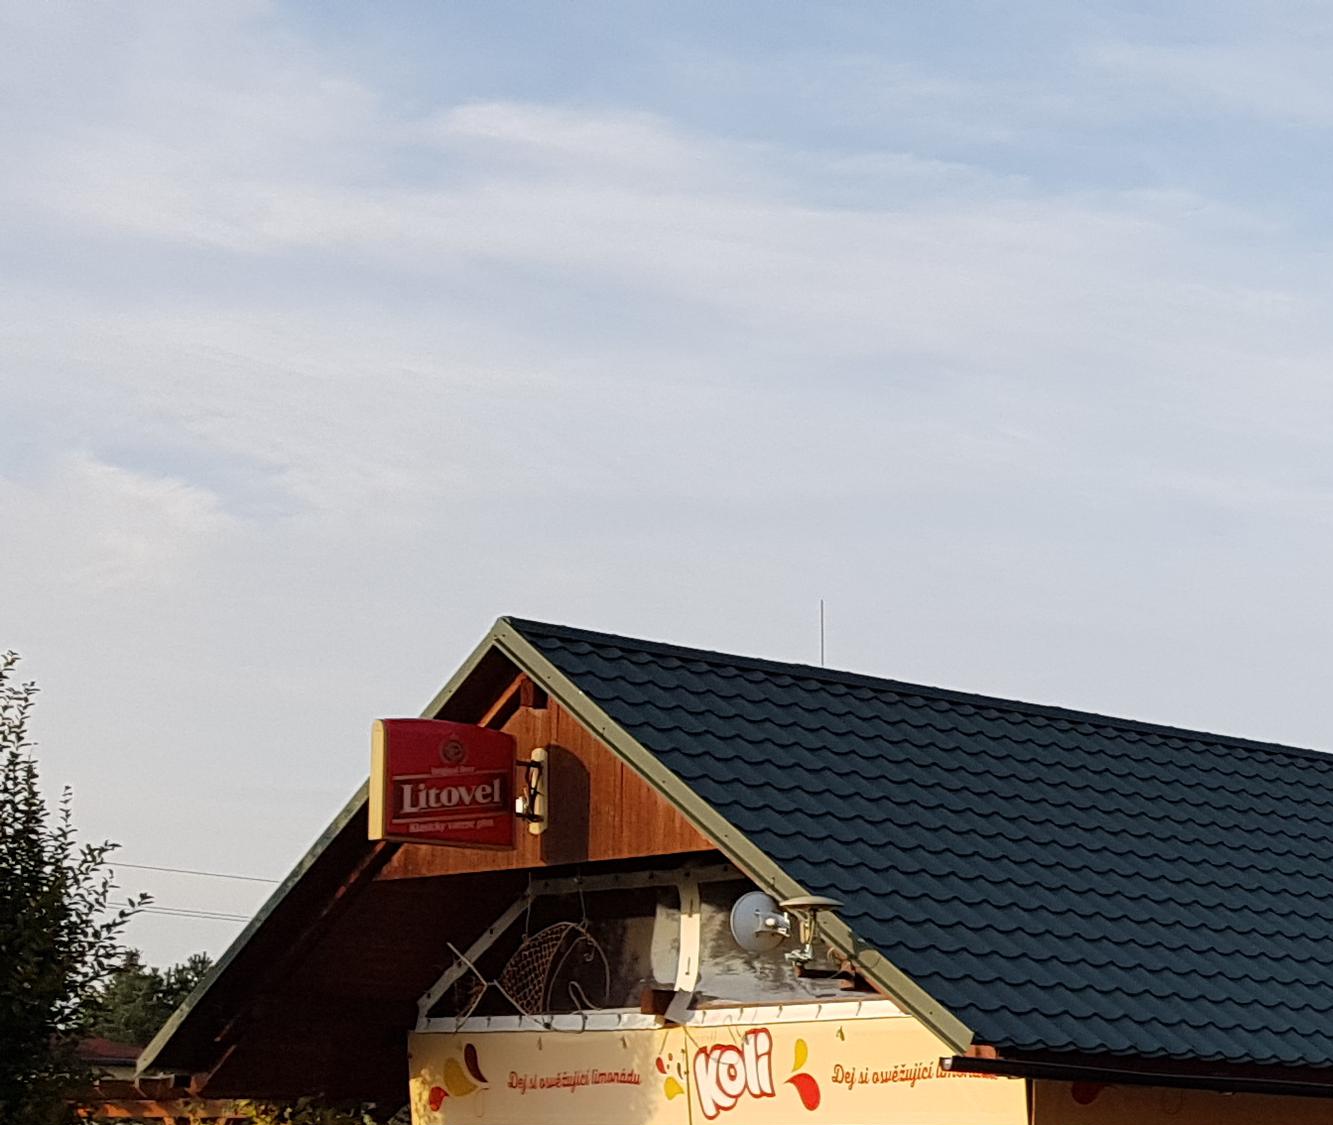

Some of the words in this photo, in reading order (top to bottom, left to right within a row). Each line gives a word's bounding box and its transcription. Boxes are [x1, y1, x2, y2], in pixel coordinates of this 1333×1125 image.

[401, 778, 500, 813] Litovel
[507, 1071, 528, 1095] Dej
[832, 1064, 856, 1090] Dej
[858, 1067, 869, 1084] si
[872, 1061, 934, 1087] osvěžující
